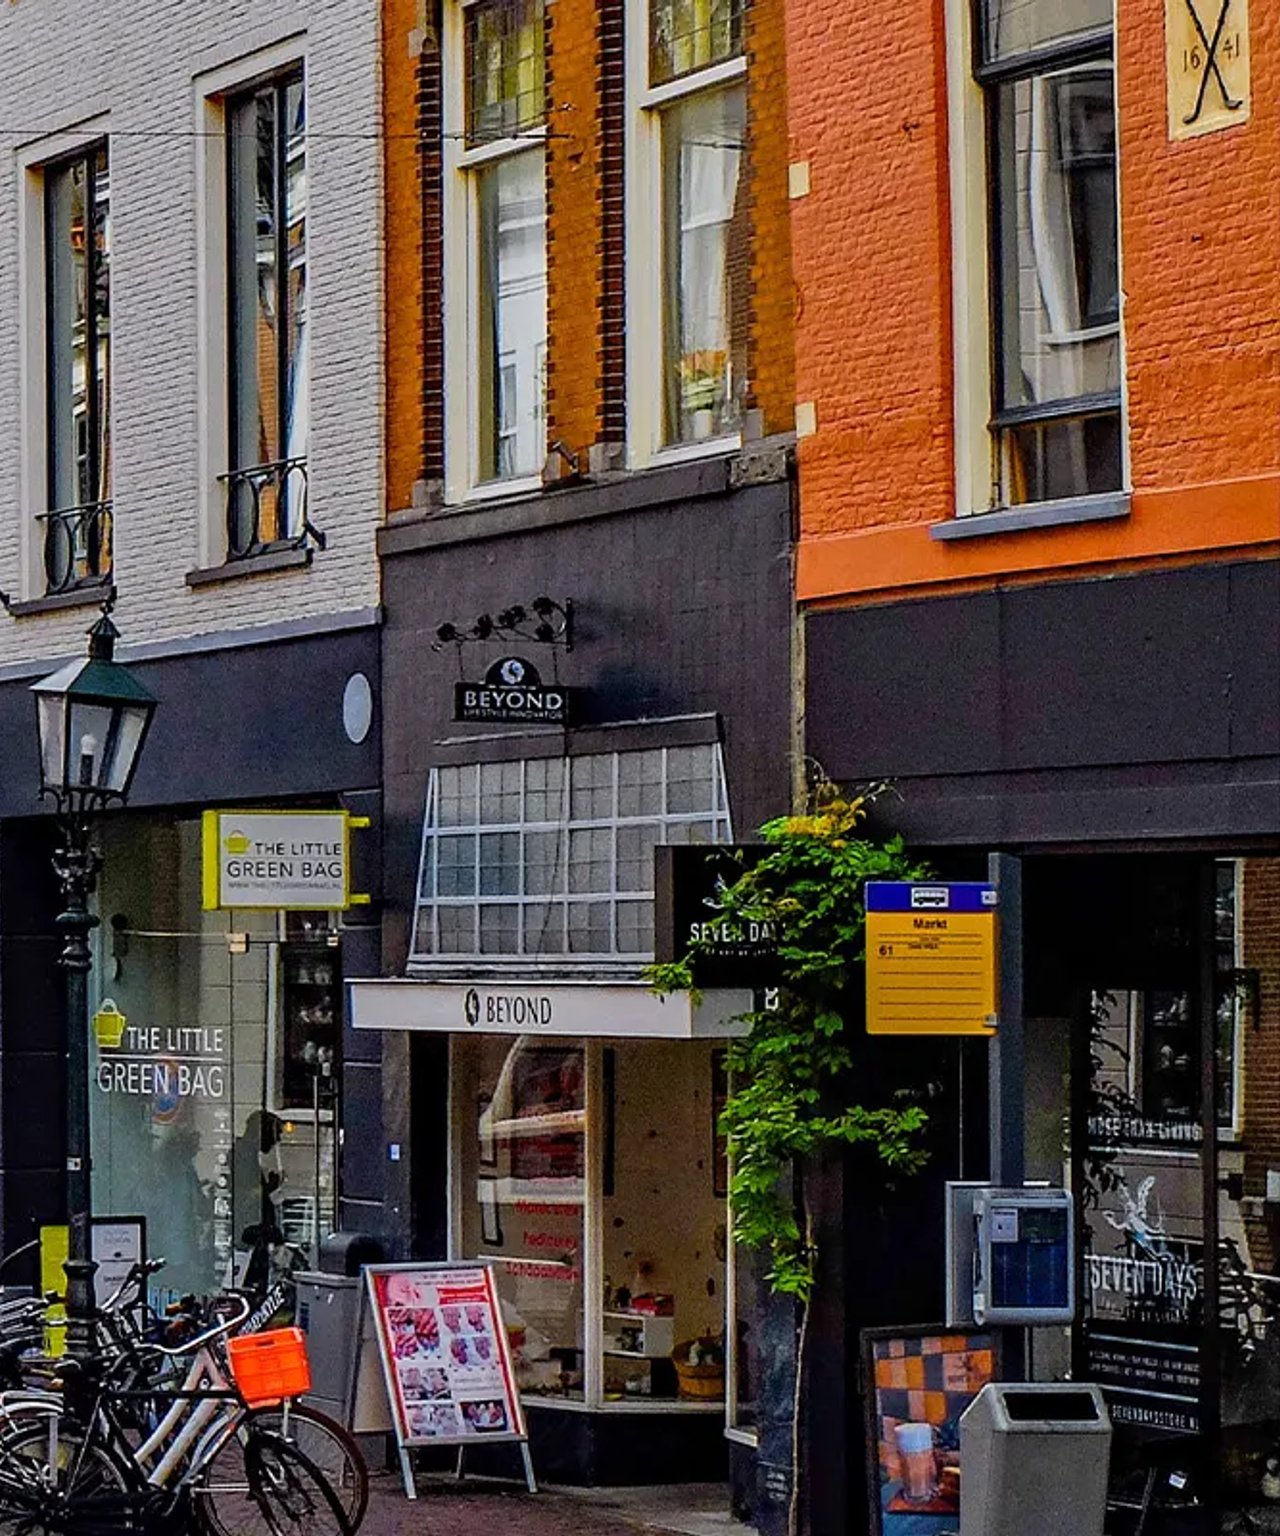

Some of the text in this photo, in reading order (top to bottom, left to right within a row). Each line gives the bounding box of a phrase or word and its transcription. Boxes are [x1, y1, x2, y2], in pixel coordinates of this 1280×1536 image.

[1183, 33, 1240, 73] 16 41
[464, 690, 563, 710] BEYOND
[255, 842, 342, 856] THE LITTLE
[226, 860, 343, 879] GREEN BAG
[913, 918, 948, 929] Markt
[878, 944, 894, 956] 61
[486, 996, 552, 1025] BEYOND
[126, 1026, 223, 1053] THE LITTLE
[97, 1061, 224, 1098] GREEN BAG
[1090, 1260, 1198, 1300] SEVEN DAYS
